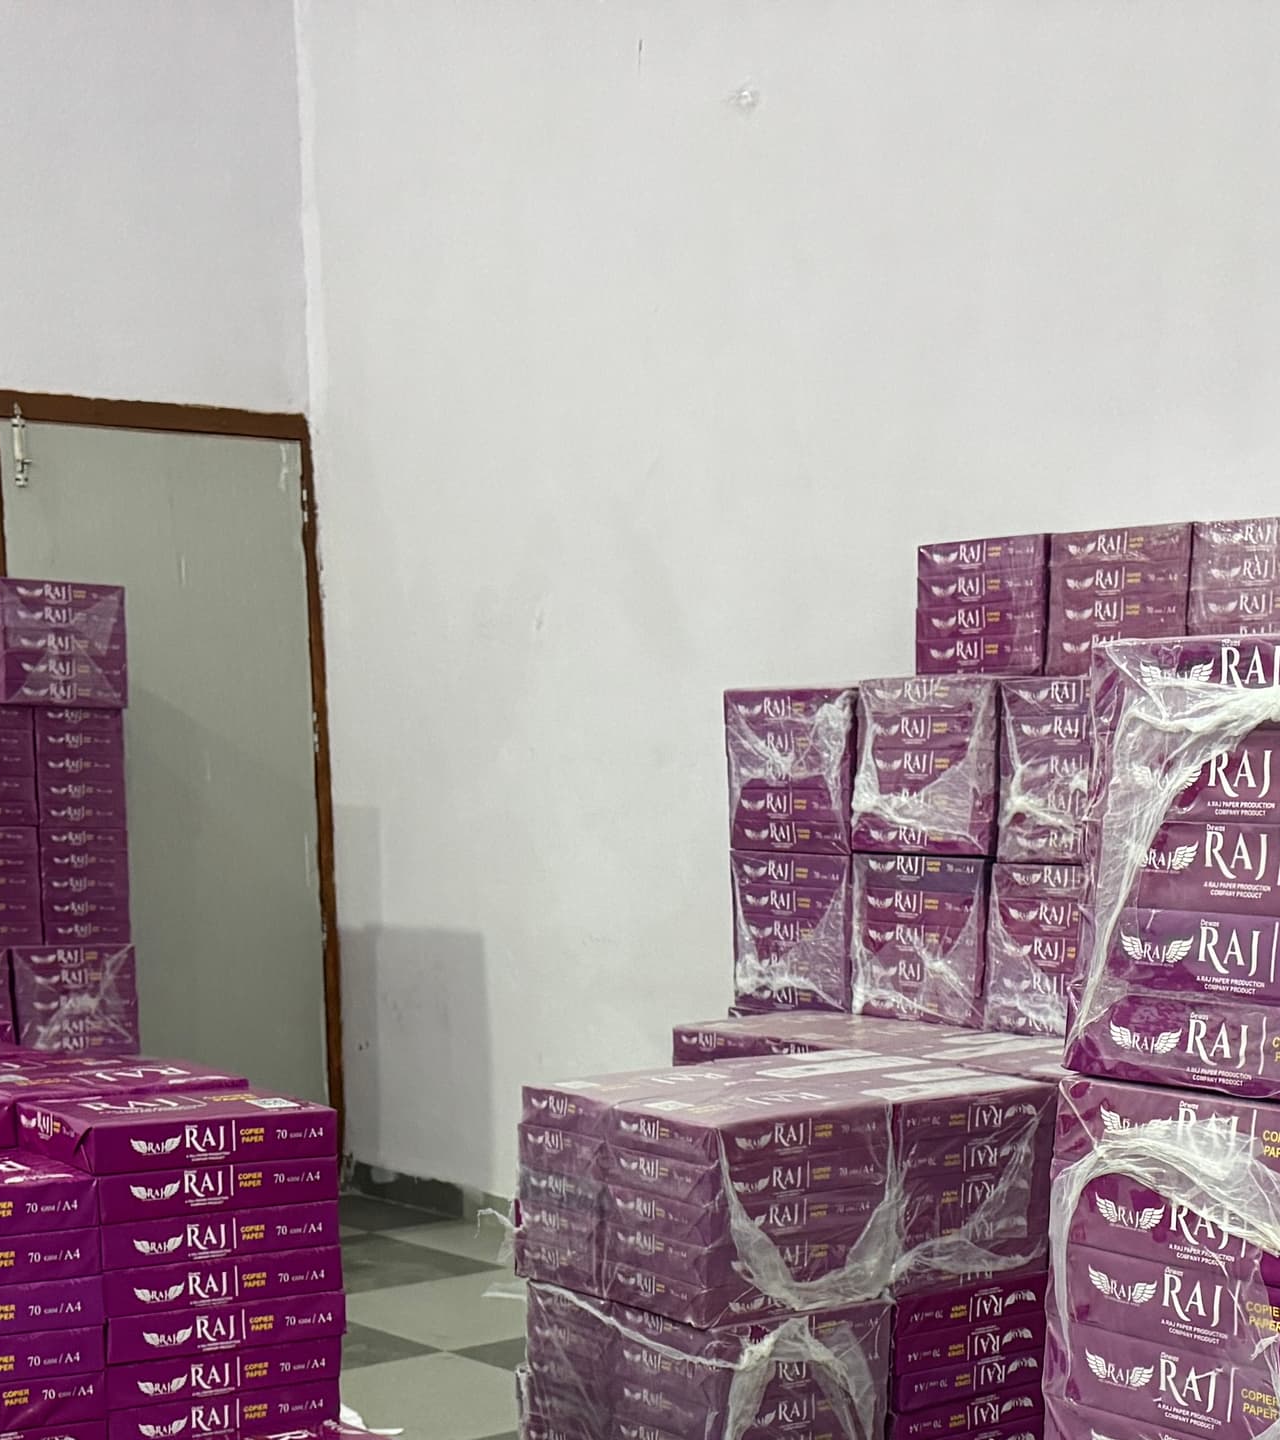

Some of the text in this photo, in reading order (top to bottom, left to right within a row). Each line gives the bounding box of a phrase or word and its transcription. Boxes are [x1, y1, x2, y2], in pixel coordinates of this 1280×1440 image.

[958, 544, 983, 565] RAJ
[1197, 922, 1261, 977] RAJ
[185, 1126, 225, 1152] RAJ
